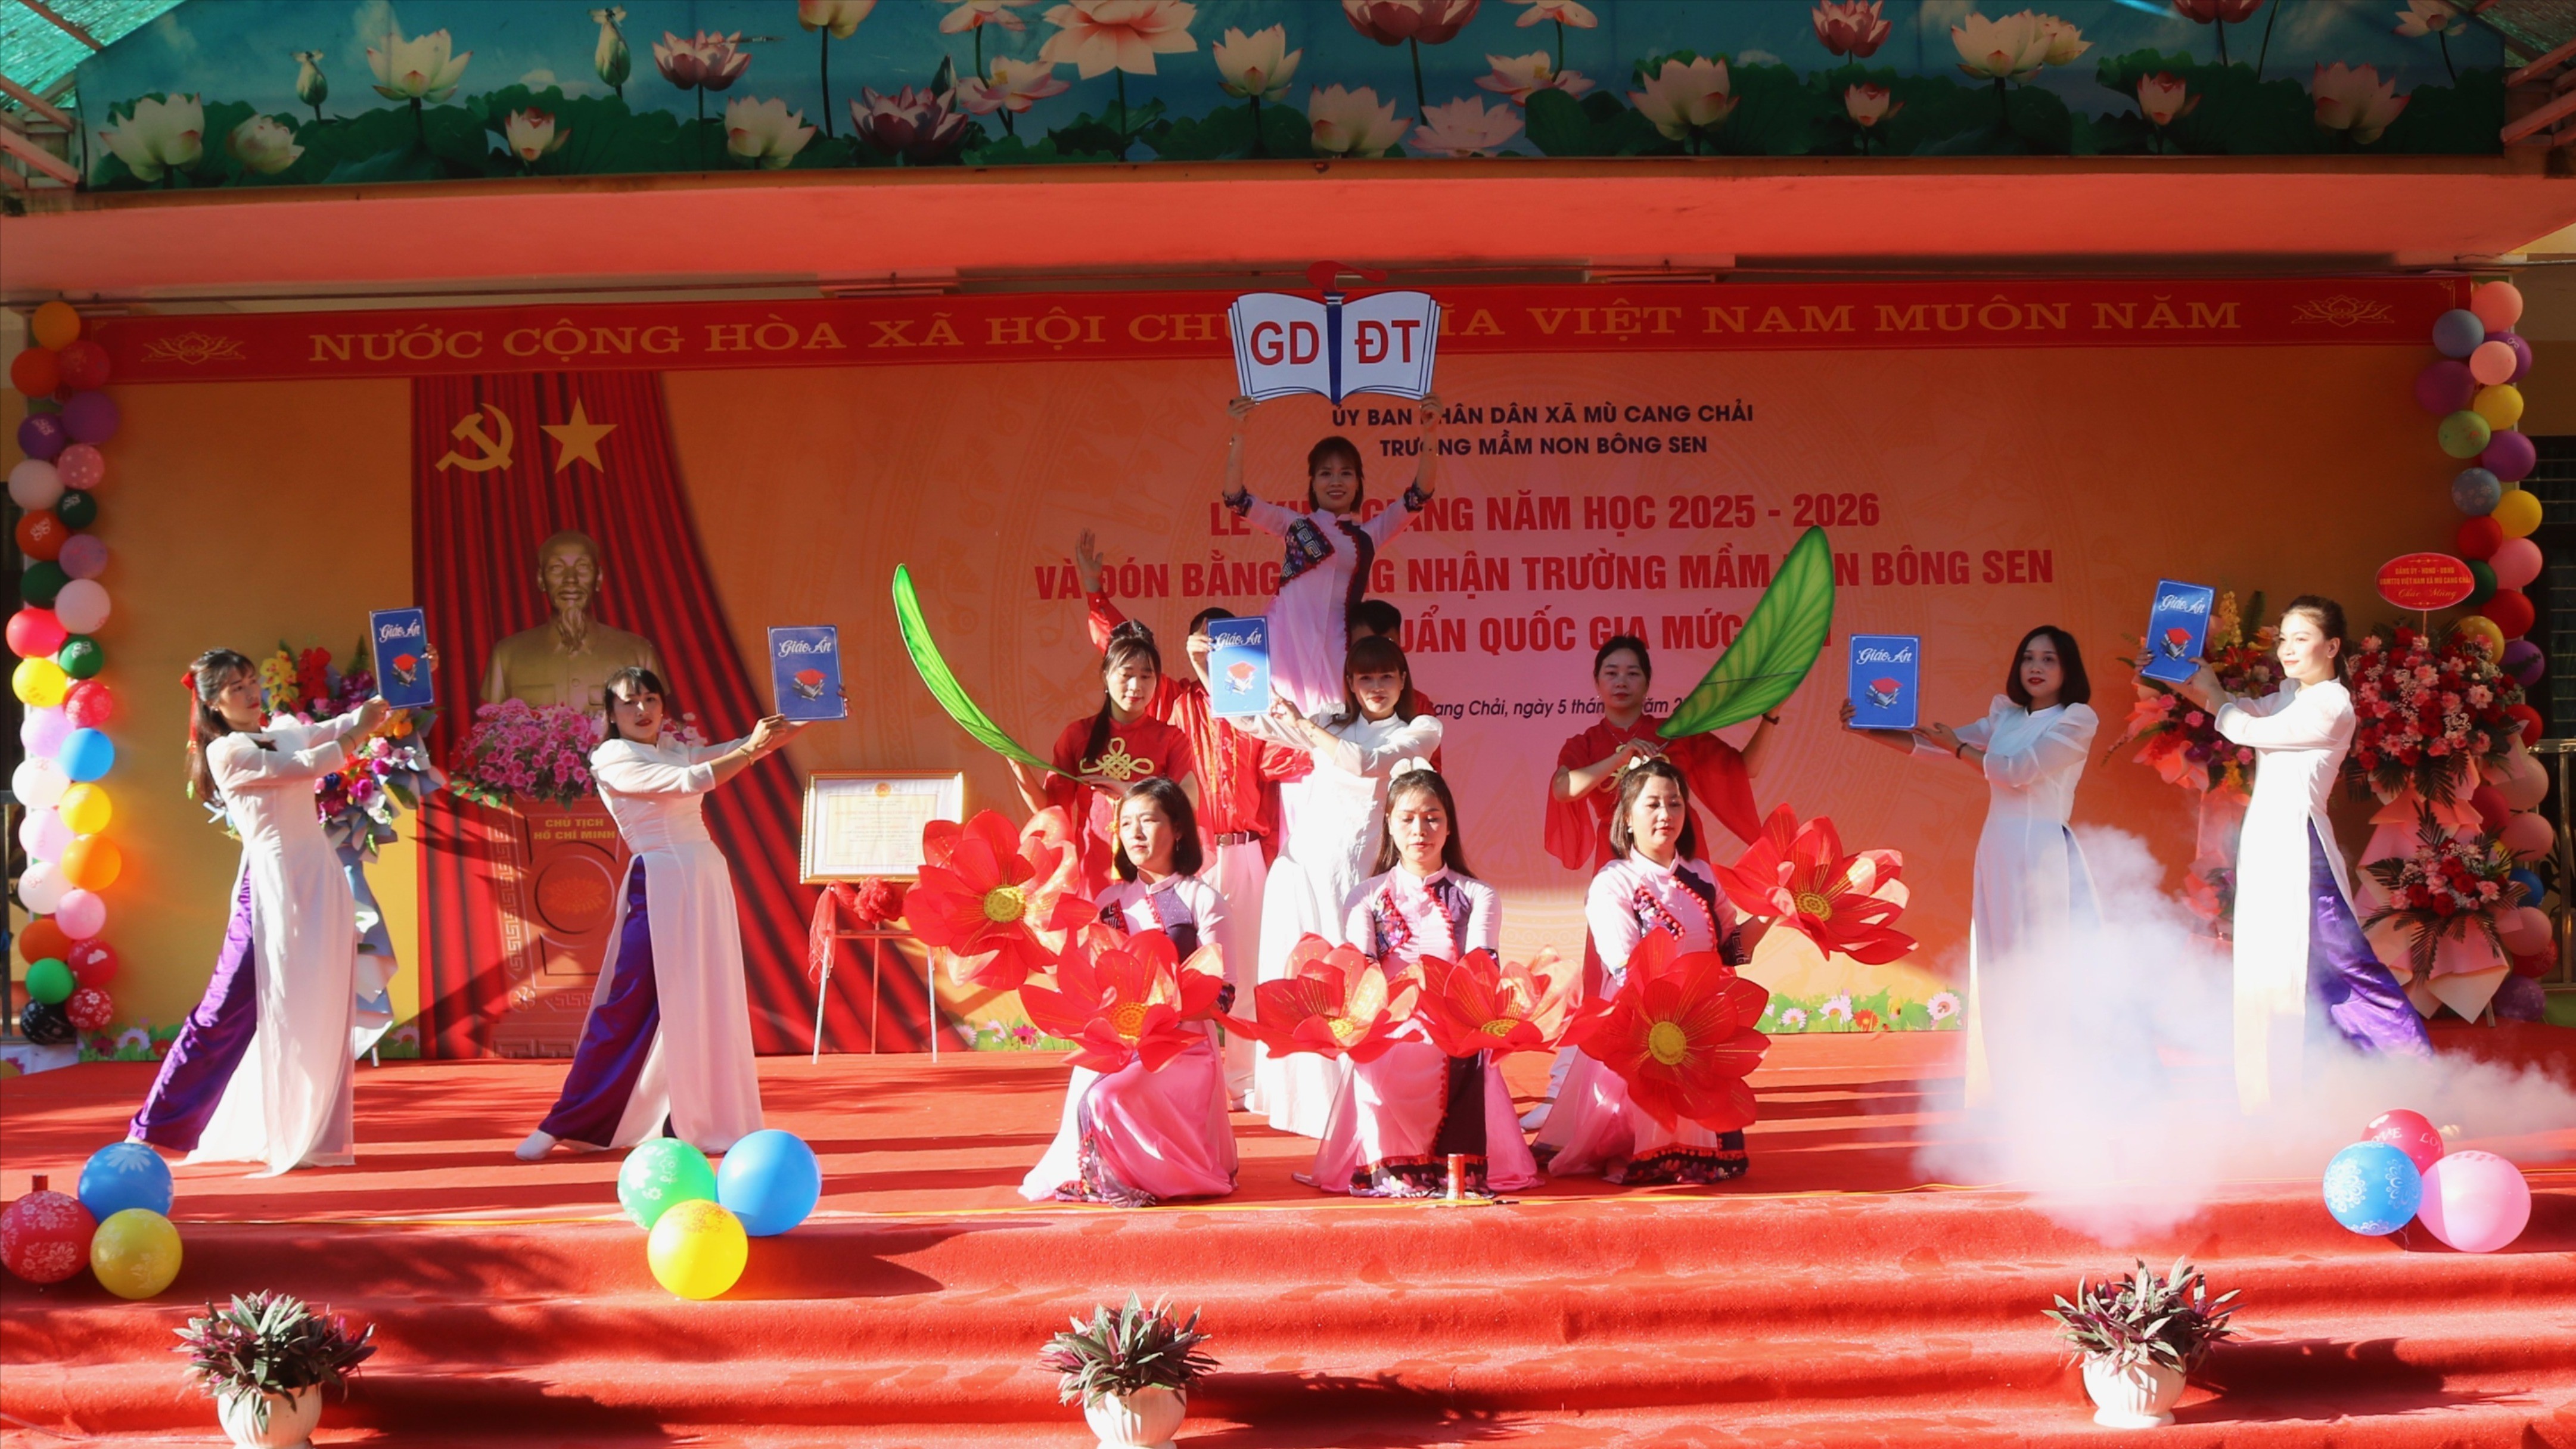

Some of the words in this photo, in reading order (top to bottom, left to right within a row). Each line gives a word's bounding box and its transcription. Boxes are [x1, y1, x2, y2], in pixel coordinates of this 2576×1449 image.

[309, 324, 483, 362] NƯỚC
[502, 318, 685, 362] CỘNG
[704, 313, 847, 352] HÒA
[868, 313, 964, 348] XÃ
[984, 306, 1107, 351] HỘI
[1129, 313, 1233, 342] CH
[1526, 298, 1683, 342] VIỆT
[1702, 304, 1855, 334] NAM
[1873, 294, 2072, 332] MUÔN
[2091, 294, 2242, 329] NĂM
[1250, 319, 1320, 366] GD
[1354, 319, 1421, 365] ĐT
[1332, 402, 1360, 427] ỦY
[1368, 409, 1412, 426] BAN
[1421, 403, 1483, 425] HÂN
[1490, 401, 1537, 424] DÂN
[1545, 403, 1578, 424] XÃ
[1584, 399, 1617, 424] MÙ
[1622, 405, 1691, 424] CANG
[1697, 398, 1754, 422] CHẢI
[1379, 437, 1471, 456] TRƯNG
[1478, 429, 1533, 455] MẦM
[1540, 436, 1589, 455] NON
[1597, 432, 1663, 454] BÔNG
[1669, 435, 1707, 453] SEN
[1487, 489, 1571, 532] NĂM
[1583, 495, 1657, 537] HỌC
[1668, 495, 1755, 530] 2025
[1793, 493, 1879, 527] 2026
[1034, 558, 1082, 600] VÀ
[1101, 557, 1169, 598] ĐÓN
[1182, 549, 1281, 596] BẰNG
[1407, 551, 1509, 599] NHẬN
[1521, 547, 1667, 591] TRƯỜNG
[1679, 543, 1770, 589] MẦM
[1872, 545, 1971, 586] BÔNG
[1982, 549, 2054, 584] SEN
[2158, 595, 2187, 611] Giáo
[2185, 597, 2205, 614] Án
[379, 624, 405, 643] Giáo
[403, 619, 421, 637] Án
[1215, 632, 1242, 651] Giáo
[1241, 627, 1261, 646] Án
[1479, 605, 1576, 655] QUỐC
[1662, 608, 1742, 649] MỨC
[778, 640, 810, 658] Giáo
[809, 636, 831, 653] Án
[1856, 648, 1890, 664] Giáo
[1888, 646, 1912, 663] Án
[1431, 702, 1464, 719] ang
[1469, 698, 1508, 717] Chải,
[1514, 698, 1553, 719] ngày
[1558, 699, 1567, 714] 5
[1571, 698, 1605, 714] thán
[1643, 698, 1668, 713] ăm
[545, 816, 571, 827] CHỦ
[575, 819, 604, 829] TỊCH
[555, 829, 576, 839] CHÍ
[581, 831, 615, 839] MINH
[2371, 1127, 2403, 1142] OVE
